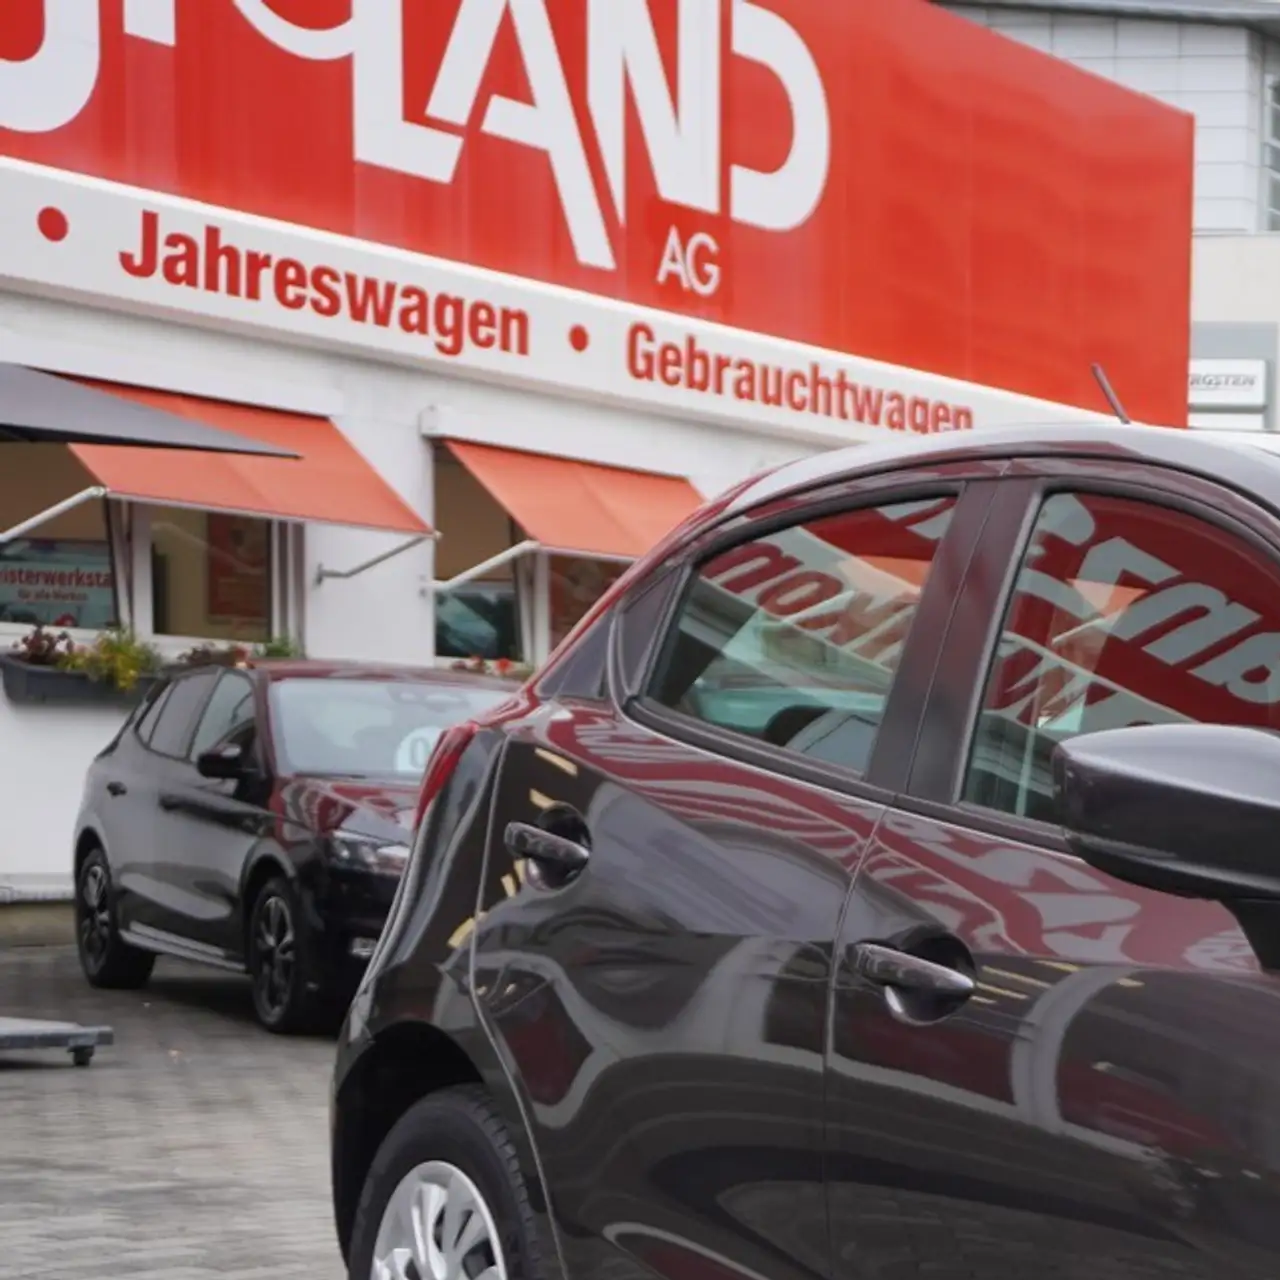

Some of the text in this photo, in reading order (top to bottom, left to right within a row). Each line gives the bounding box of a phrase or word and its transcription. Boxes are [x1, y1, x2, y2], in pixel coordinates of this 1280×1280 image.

[118, 208, 974, 435] Jahreswagen Gebrauchtwagen
[656, 225, 721, 297] AG
